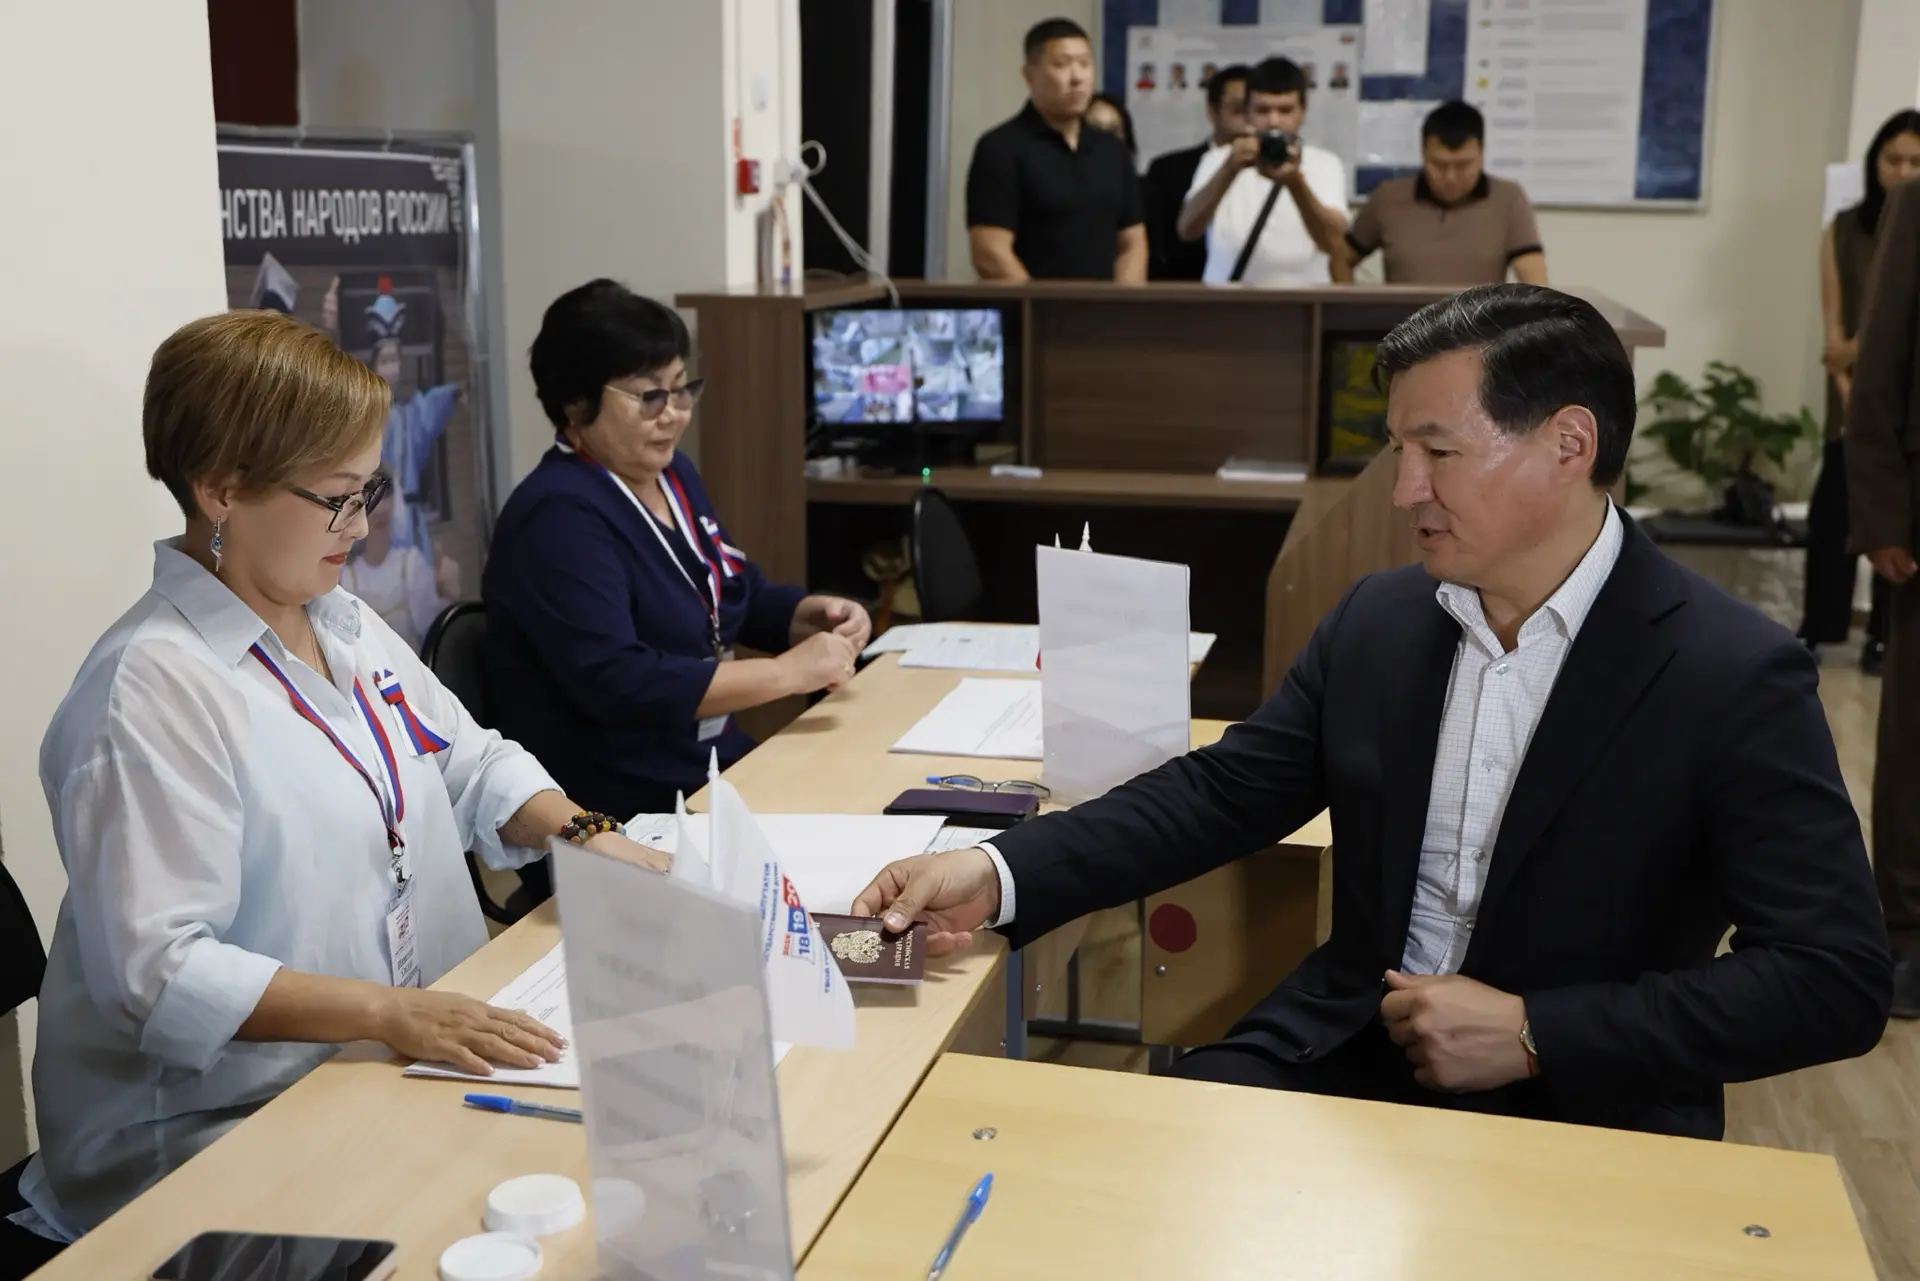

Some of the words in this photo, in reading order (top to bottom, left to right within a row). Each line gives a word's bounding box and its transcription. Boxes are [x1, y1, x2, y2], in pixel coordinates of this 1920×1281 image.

[219, 188, 287, 239] НСТВА
[292, 188, 383, 244] НАРОДОВ
[385, 189, 449, 234] РОССИИ
[786, 881, 799, 906] 20
[792, 909, 805, 931] 19
[798, 935, 810, 955] 18
[893, 936, 904, 967] ДЕРАЦИЯ
